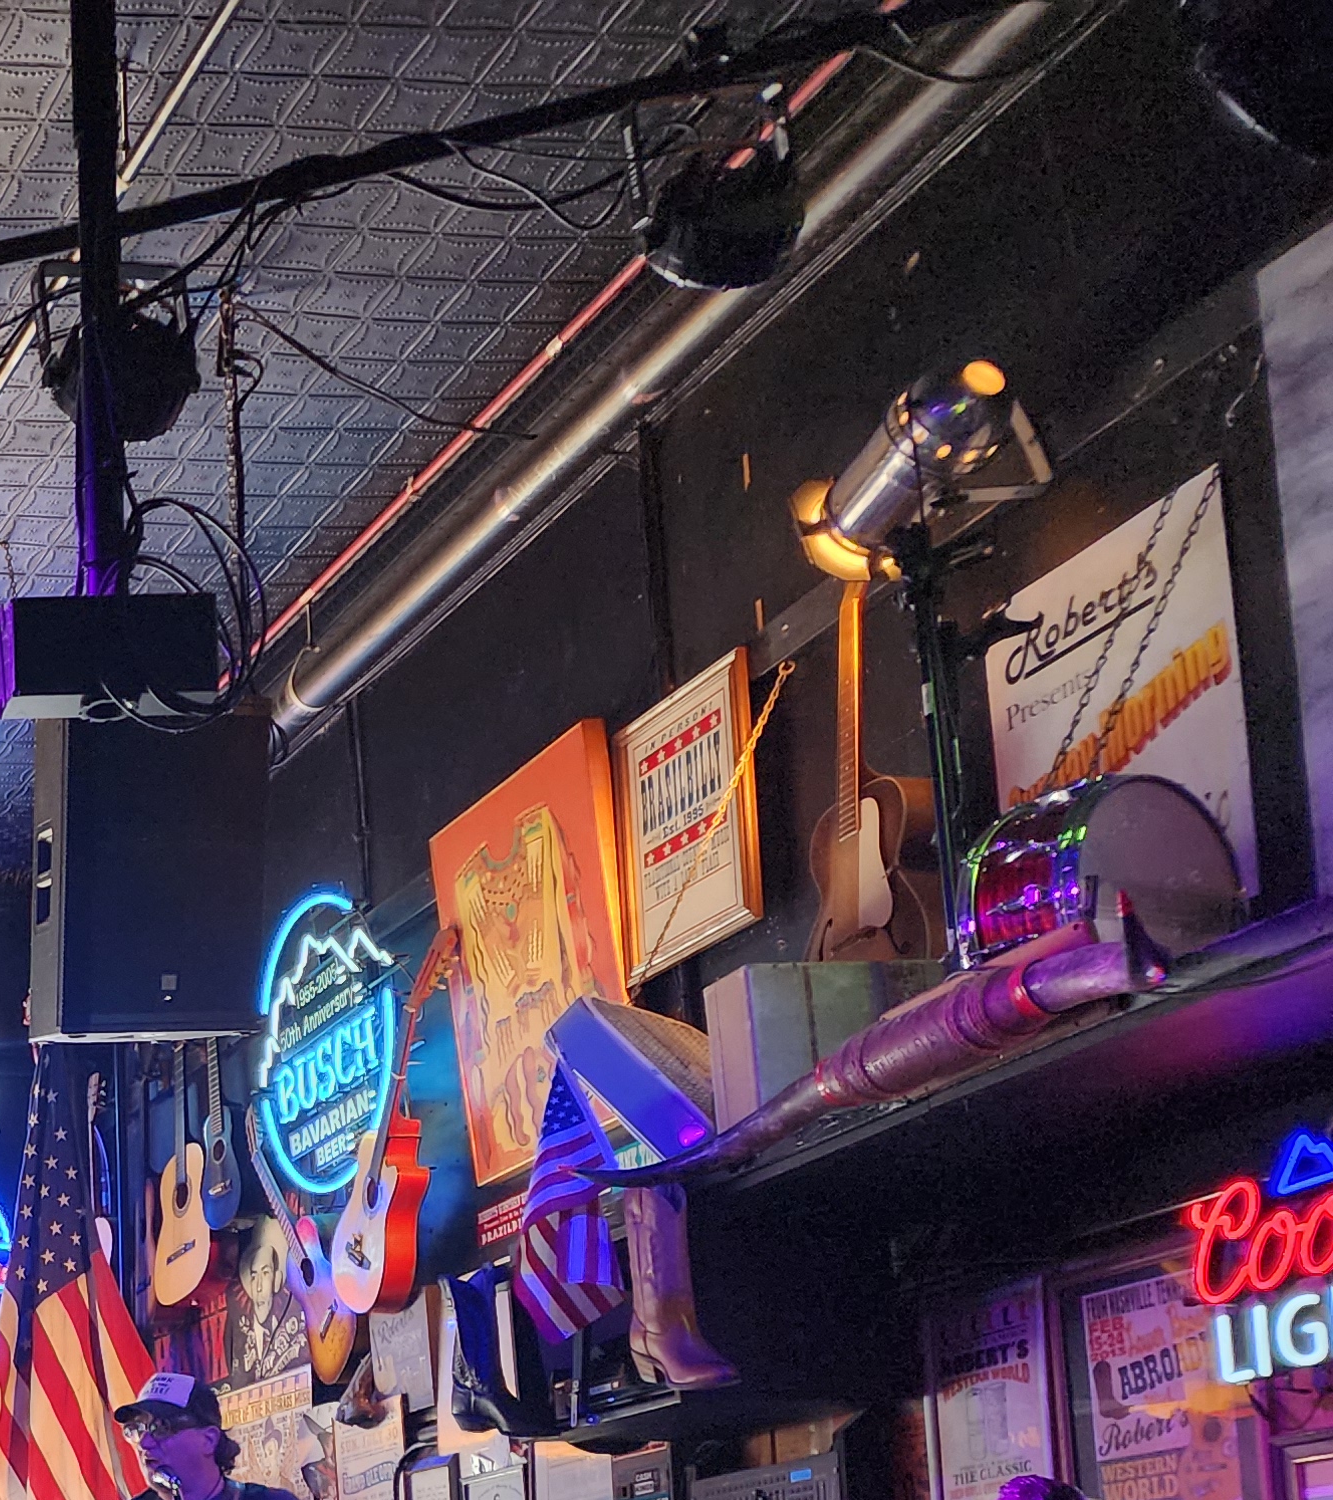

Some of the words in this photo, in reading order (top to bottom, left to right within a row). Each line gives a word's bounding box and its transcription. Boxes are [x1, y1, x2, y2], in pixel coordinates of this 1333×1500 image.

[1005, 552, 1159, 685] Robert's
[1006, 668, 1097, 731] Presents
[684, 804, 705, 825] 1995
[294, 961, 338, 1011] 1955-2005
[280, 1022, 301, 1052] 50th
[302, 986, 356, 1034] Anniversary
[275, 1003, 379, 1124] BUSCH
[289, 1092, 370, 1158] BAVARIAN
[316, 1135, 347, 1166] BEER
[1088, 1316, 1125, 1335] FEB
[1215, 1293, 1333, 1385] LIG
[942, 1369, 990, 1404] WESTERN
[991, 1361, 1031, 1389] WORLD
[1099, 1408, 1188, 1457] Robert's
[952, 1472, 978, 1487] THE
[980, 1458, 1033, 1483] CLASSIC
[1101, 1452, 1178, 1484] WESTERN
